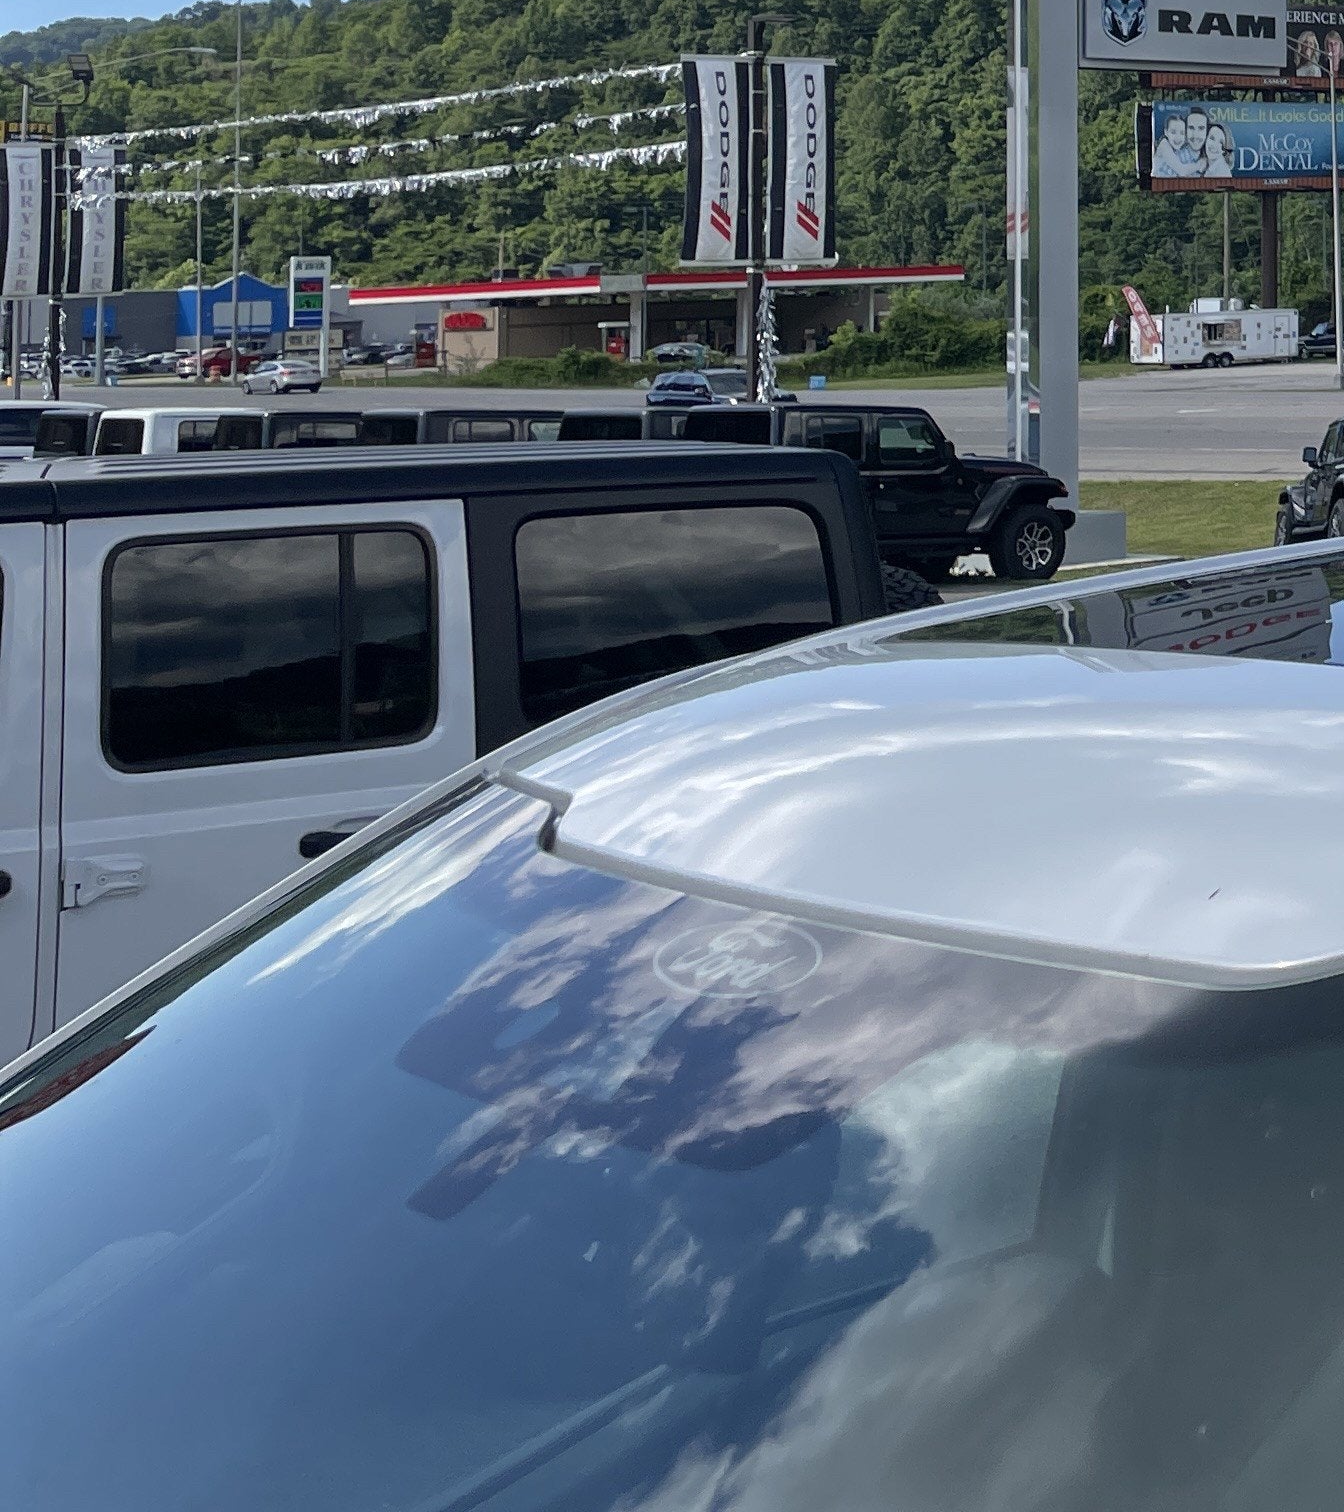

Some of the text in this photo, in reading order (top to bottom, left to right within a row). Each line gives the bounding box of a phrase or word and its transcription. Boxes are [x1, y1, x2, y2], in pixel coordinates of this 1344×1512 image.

[1158, 9, 1276, 39] RAM
[715, 71, 730, 215] DODGE
[804, 74, 817, 213] DODGE
[1269, 108, 1304, 123] Looks
[1238, 146, 1316, 171] DENTAL
[16, 162, 34, 291] CHRYSLER
[667, 926, 798, 989] Ford
